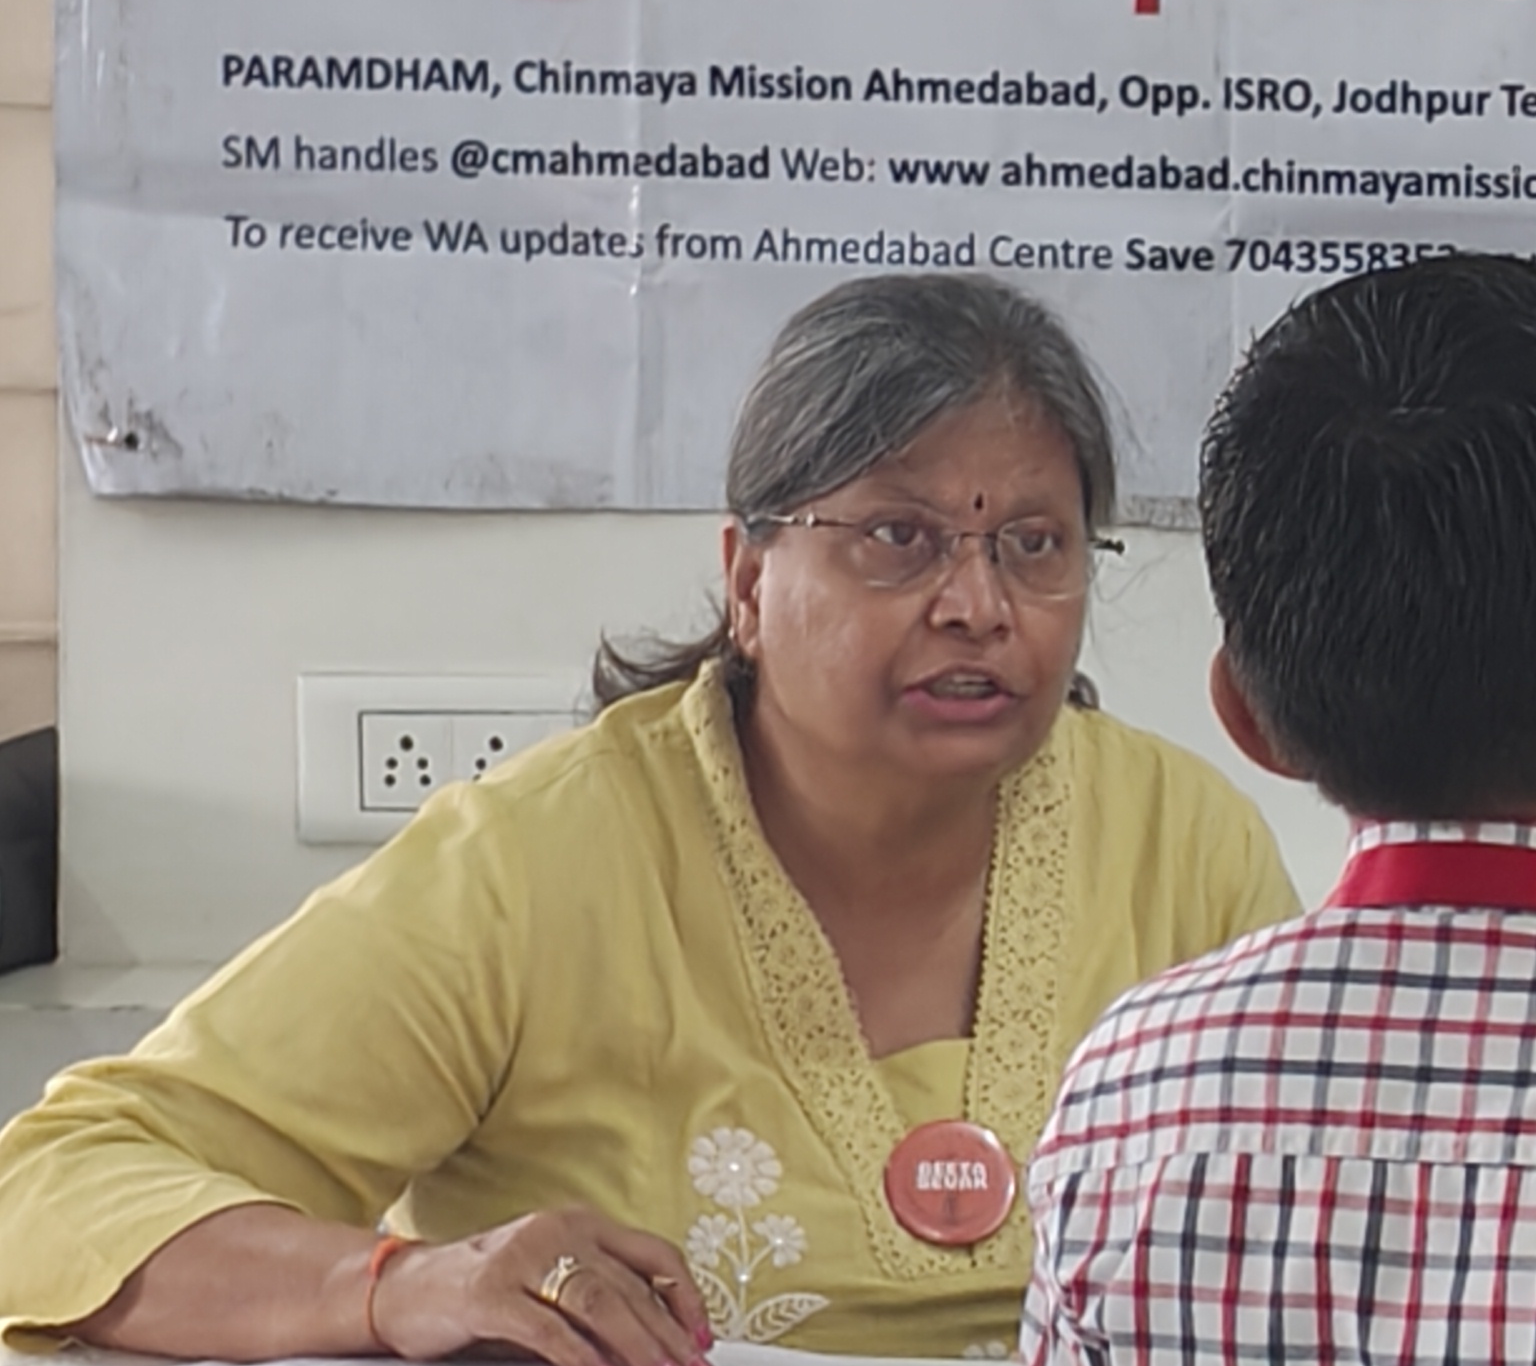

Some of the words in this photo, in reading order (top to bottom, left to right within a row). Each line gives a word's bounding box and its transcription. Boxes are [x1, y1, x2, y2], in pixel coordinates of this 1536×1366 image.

[223, 54, 501, 98] PARAMDHAM,
[514, 59, 697, 104] Chinmaya
[709, 64, 852, 101] Mission
[863, 68, 1108, 113] Ahmedabad,
[1119, 75, 1211, 117] Opp.
[1223, 77, 1322, 118] ISRO,
[1332, 80, 1492, 124] Jodhpur
[223, 135, 280, 169] SM
[294, 135, 439, 173] handles
[451, 139, 770, 179] @cmahmedabad
[780, 147, 875, 182] Web:
[224, 214, 266, 248] To
[280, 218, 413, 251] receive
[423, 220, 489, 253] WA
[500, 222, 644, 262] updates
[655, 223, 742, 260] from
[753, 228, 976, 267] Ahmedabad
[989, 235, 1113, 270] Centre
[1126, 238, 1215, 272] Save
